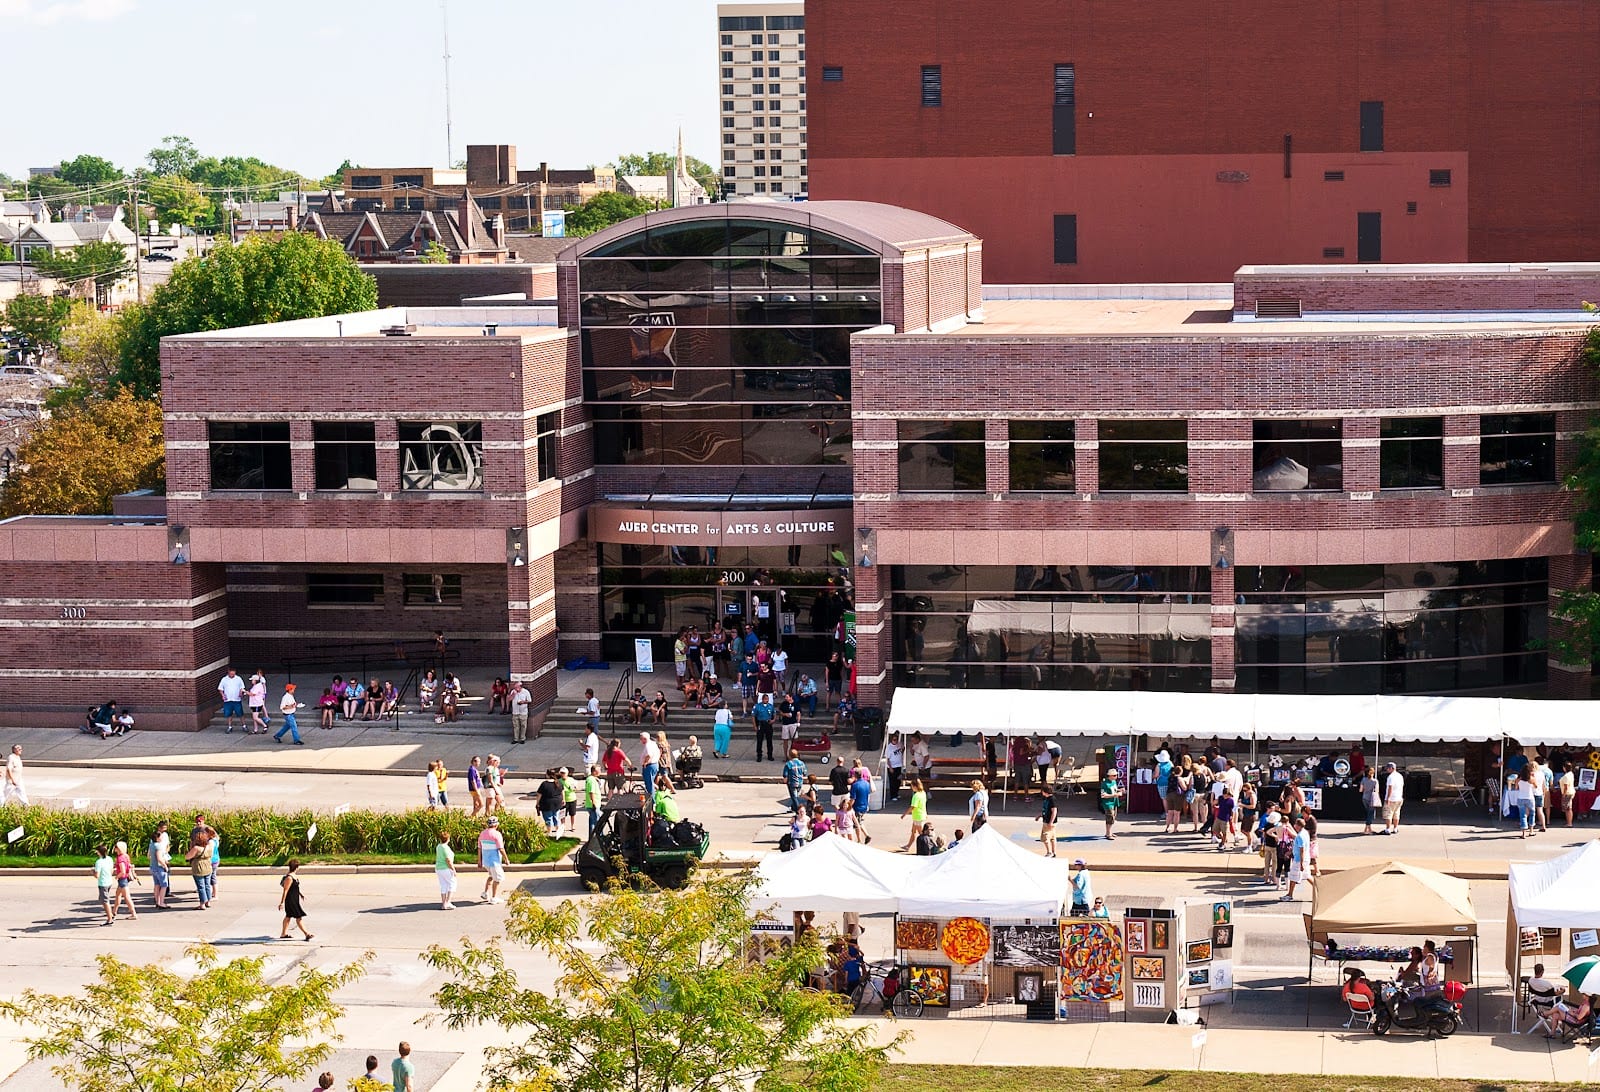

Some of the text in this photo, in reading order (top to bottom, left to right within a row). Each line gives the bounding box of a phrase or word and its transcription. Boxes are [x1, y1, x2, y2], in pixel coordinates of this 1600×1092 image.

[618, 521, 835, 534] AUER CENTER for ARTS & CULTURE
[721, 571, 745, 583] 300
[60, 607, 86, 619] 300
[1116, 749, 1126, 788] SODA
